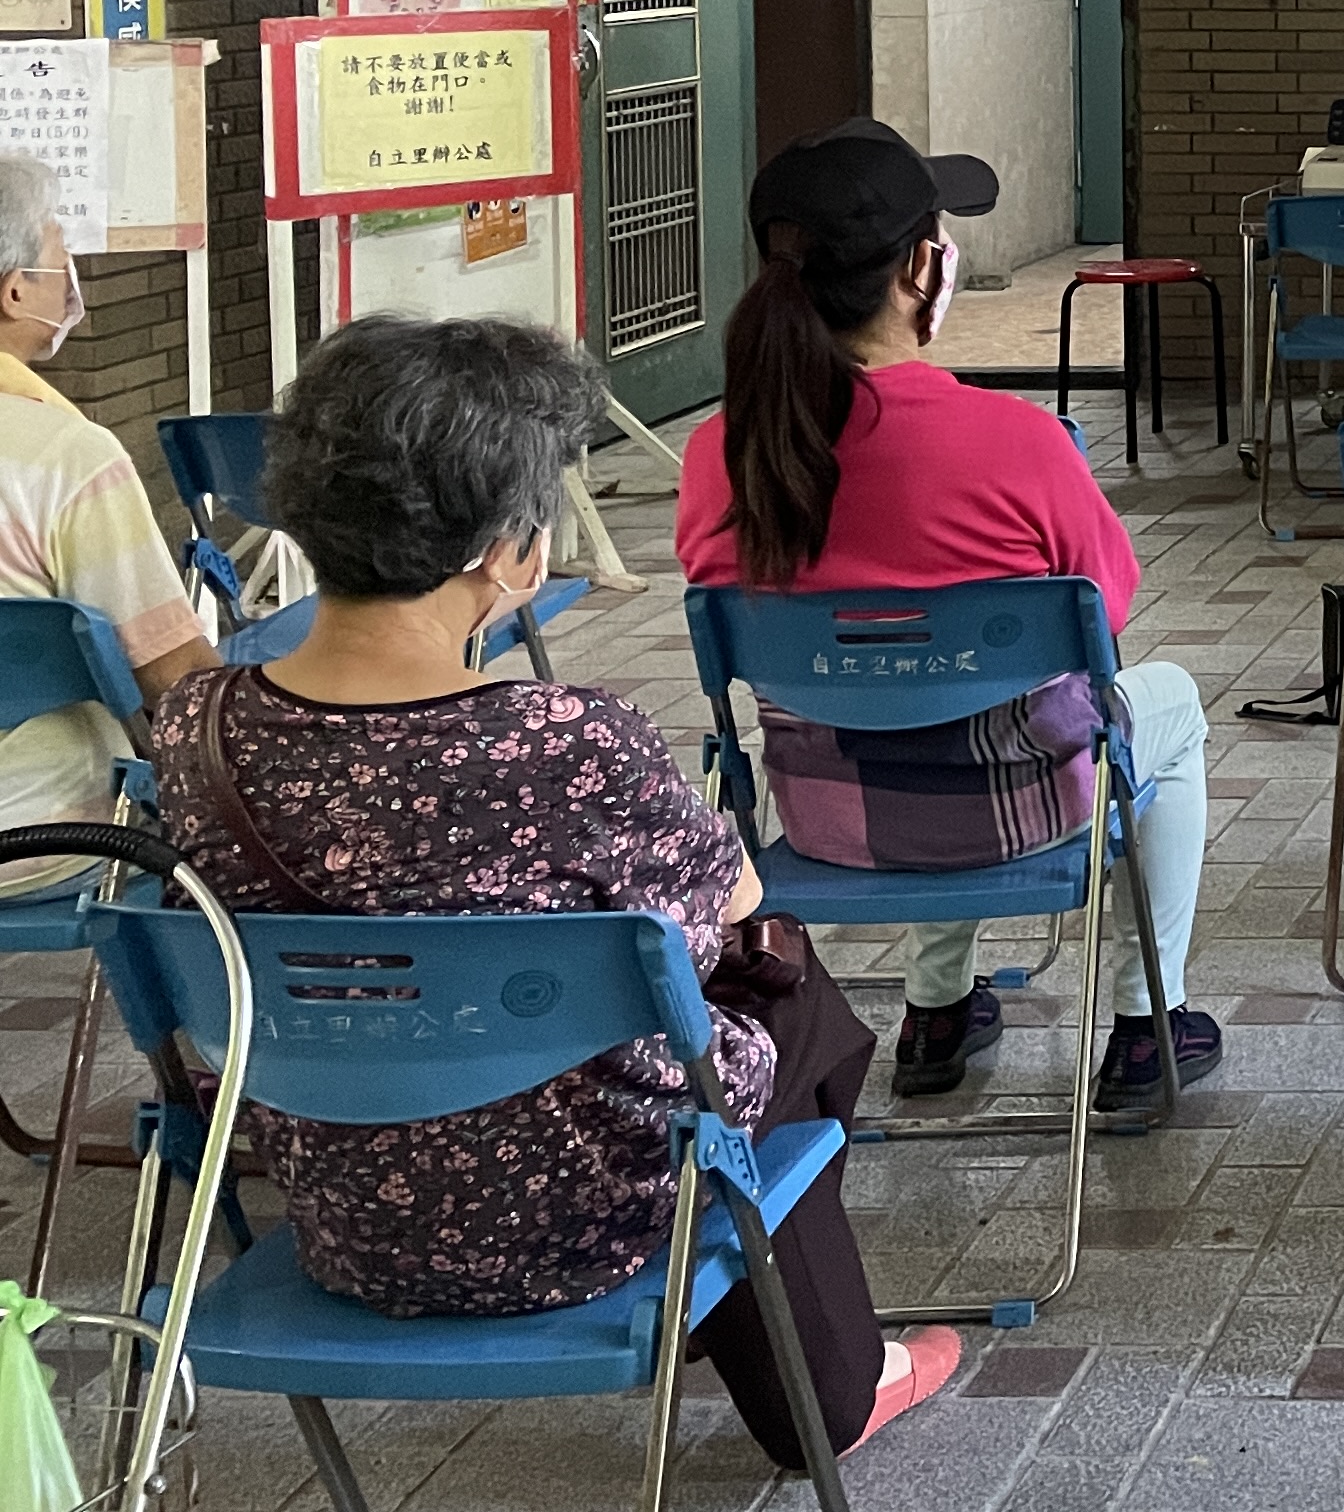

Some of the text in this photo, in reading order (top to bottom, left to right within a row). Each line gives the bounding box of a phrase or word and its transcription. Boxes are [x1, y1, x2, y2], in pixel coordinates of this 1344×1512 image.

[341, 49, 513, 75] 請不要放置便當或
[366, 73, 487, 96] 食物在門口。
[368, 142, 493, 168] 自立里辦公處
